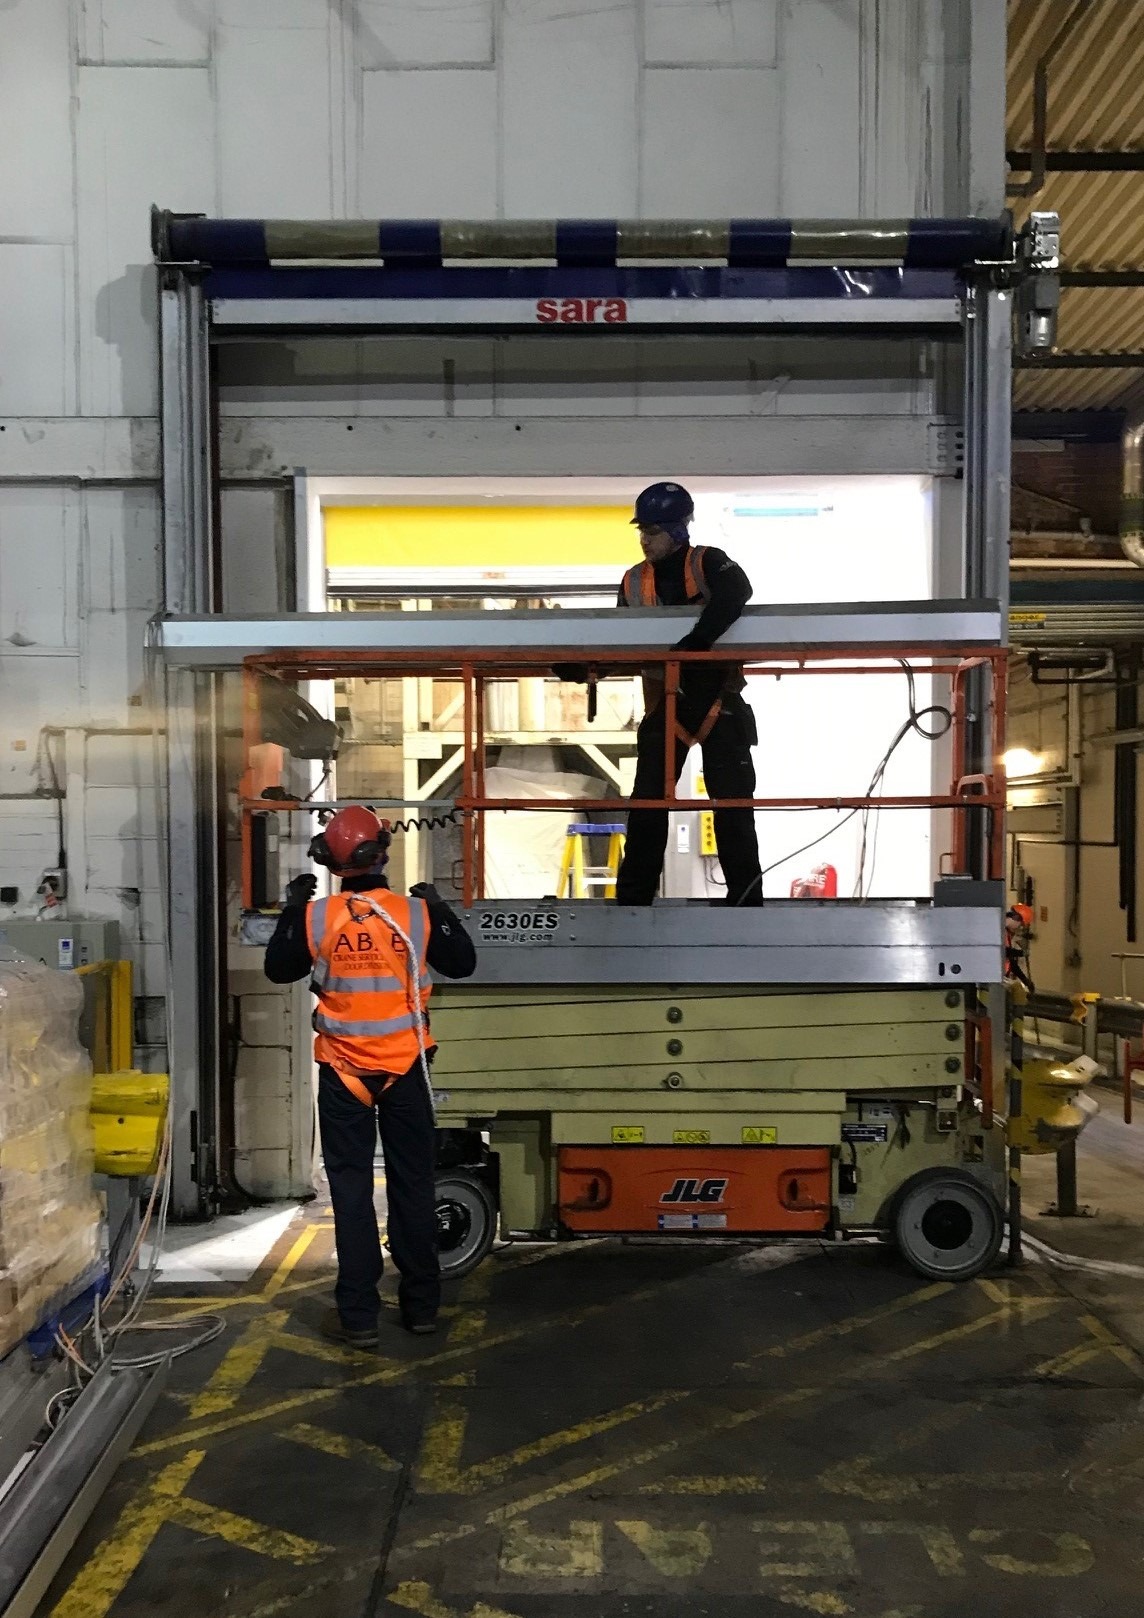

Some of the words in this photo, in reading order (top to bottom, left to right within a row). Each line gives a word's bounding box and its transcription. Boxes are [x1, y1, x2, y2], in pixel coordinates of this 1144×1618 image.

[536, 298, 627, 323] sara
[480, 912, 559, 930] 2630ES
[483, 933, 553, 942] www.jlg.com
[659, 1178, 729, 1204] JLG
[498, 1518, 1096, 1579] CLEAR
